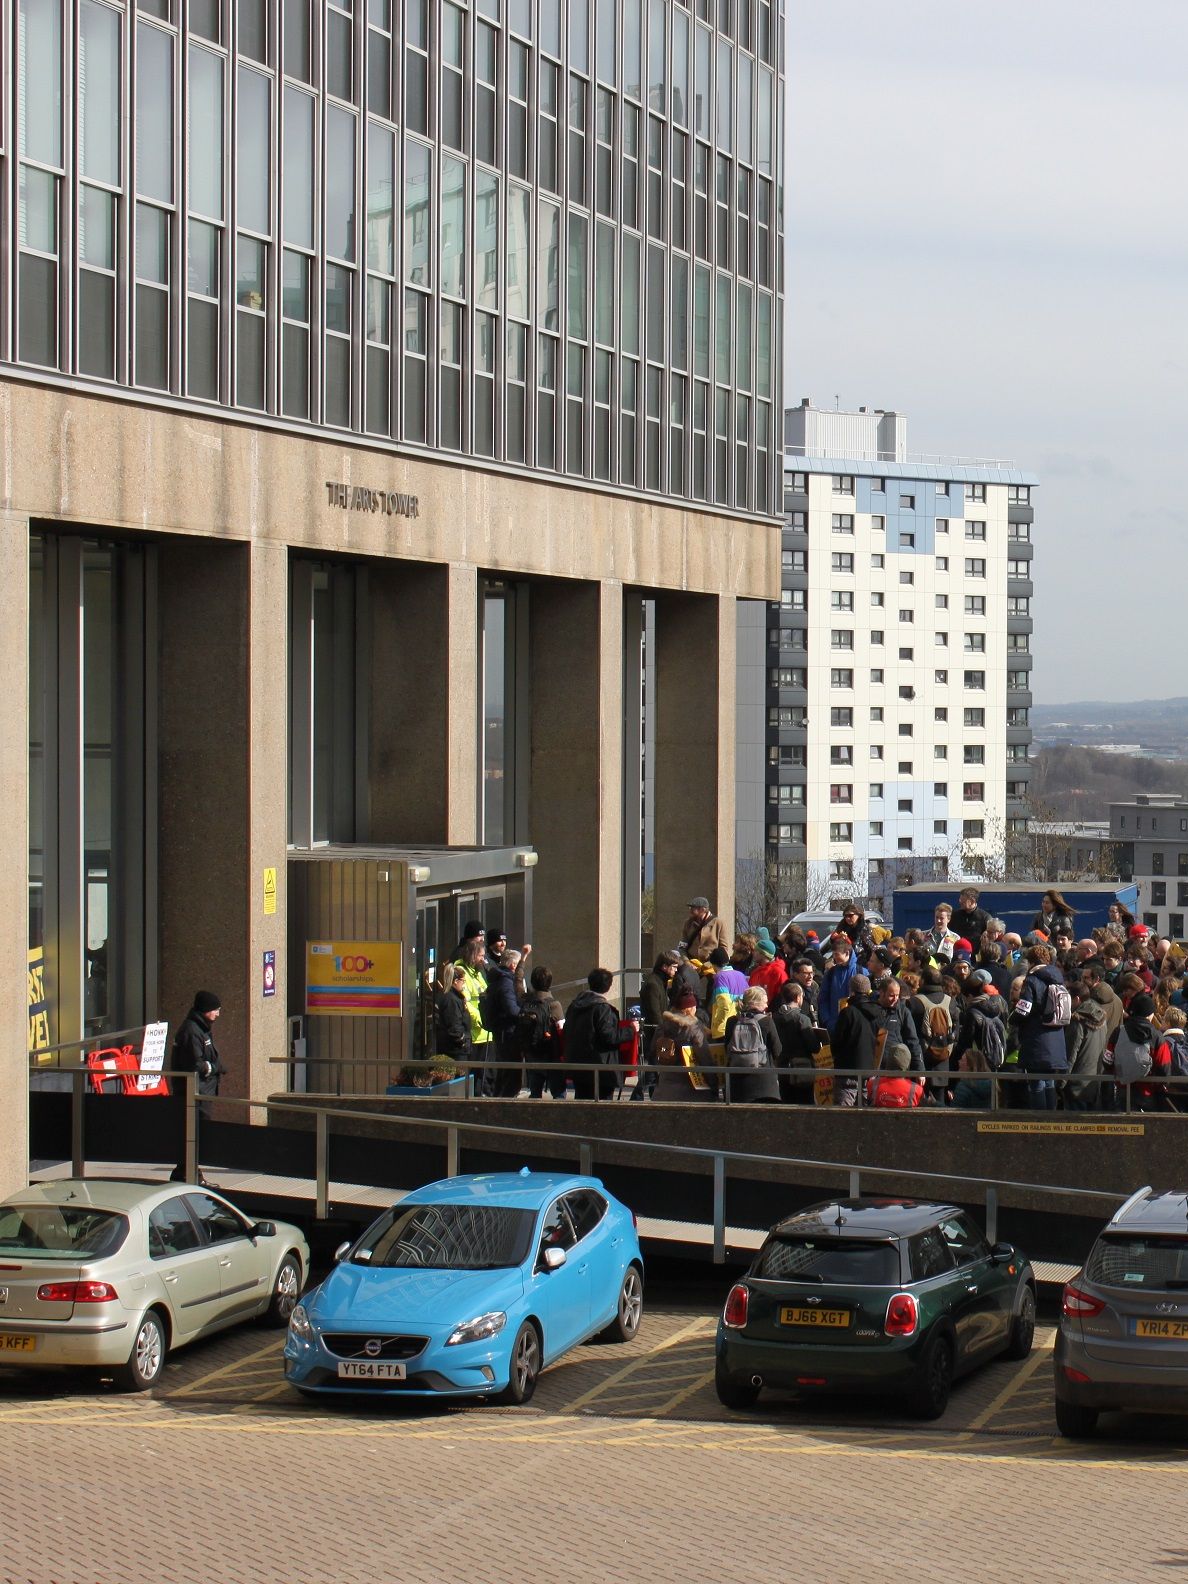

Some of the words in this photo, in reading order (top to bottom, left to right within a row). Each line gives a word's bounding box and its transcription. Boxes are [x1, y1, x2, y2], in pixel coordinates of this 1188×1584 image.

[379, 490, 419, 519] TOWER
[333, 955, 374, 973] 100+
[786, 1309, 817, 1323] BJ66
[820, 1311, 845, 1325] XGT
[1141, 1319, 1169, 1335] YR14
[6, 1336, 30, 1349] KFF
[343, 1363, 375, 1376] YT64
[377, 1364, 401, 1377] FTA
